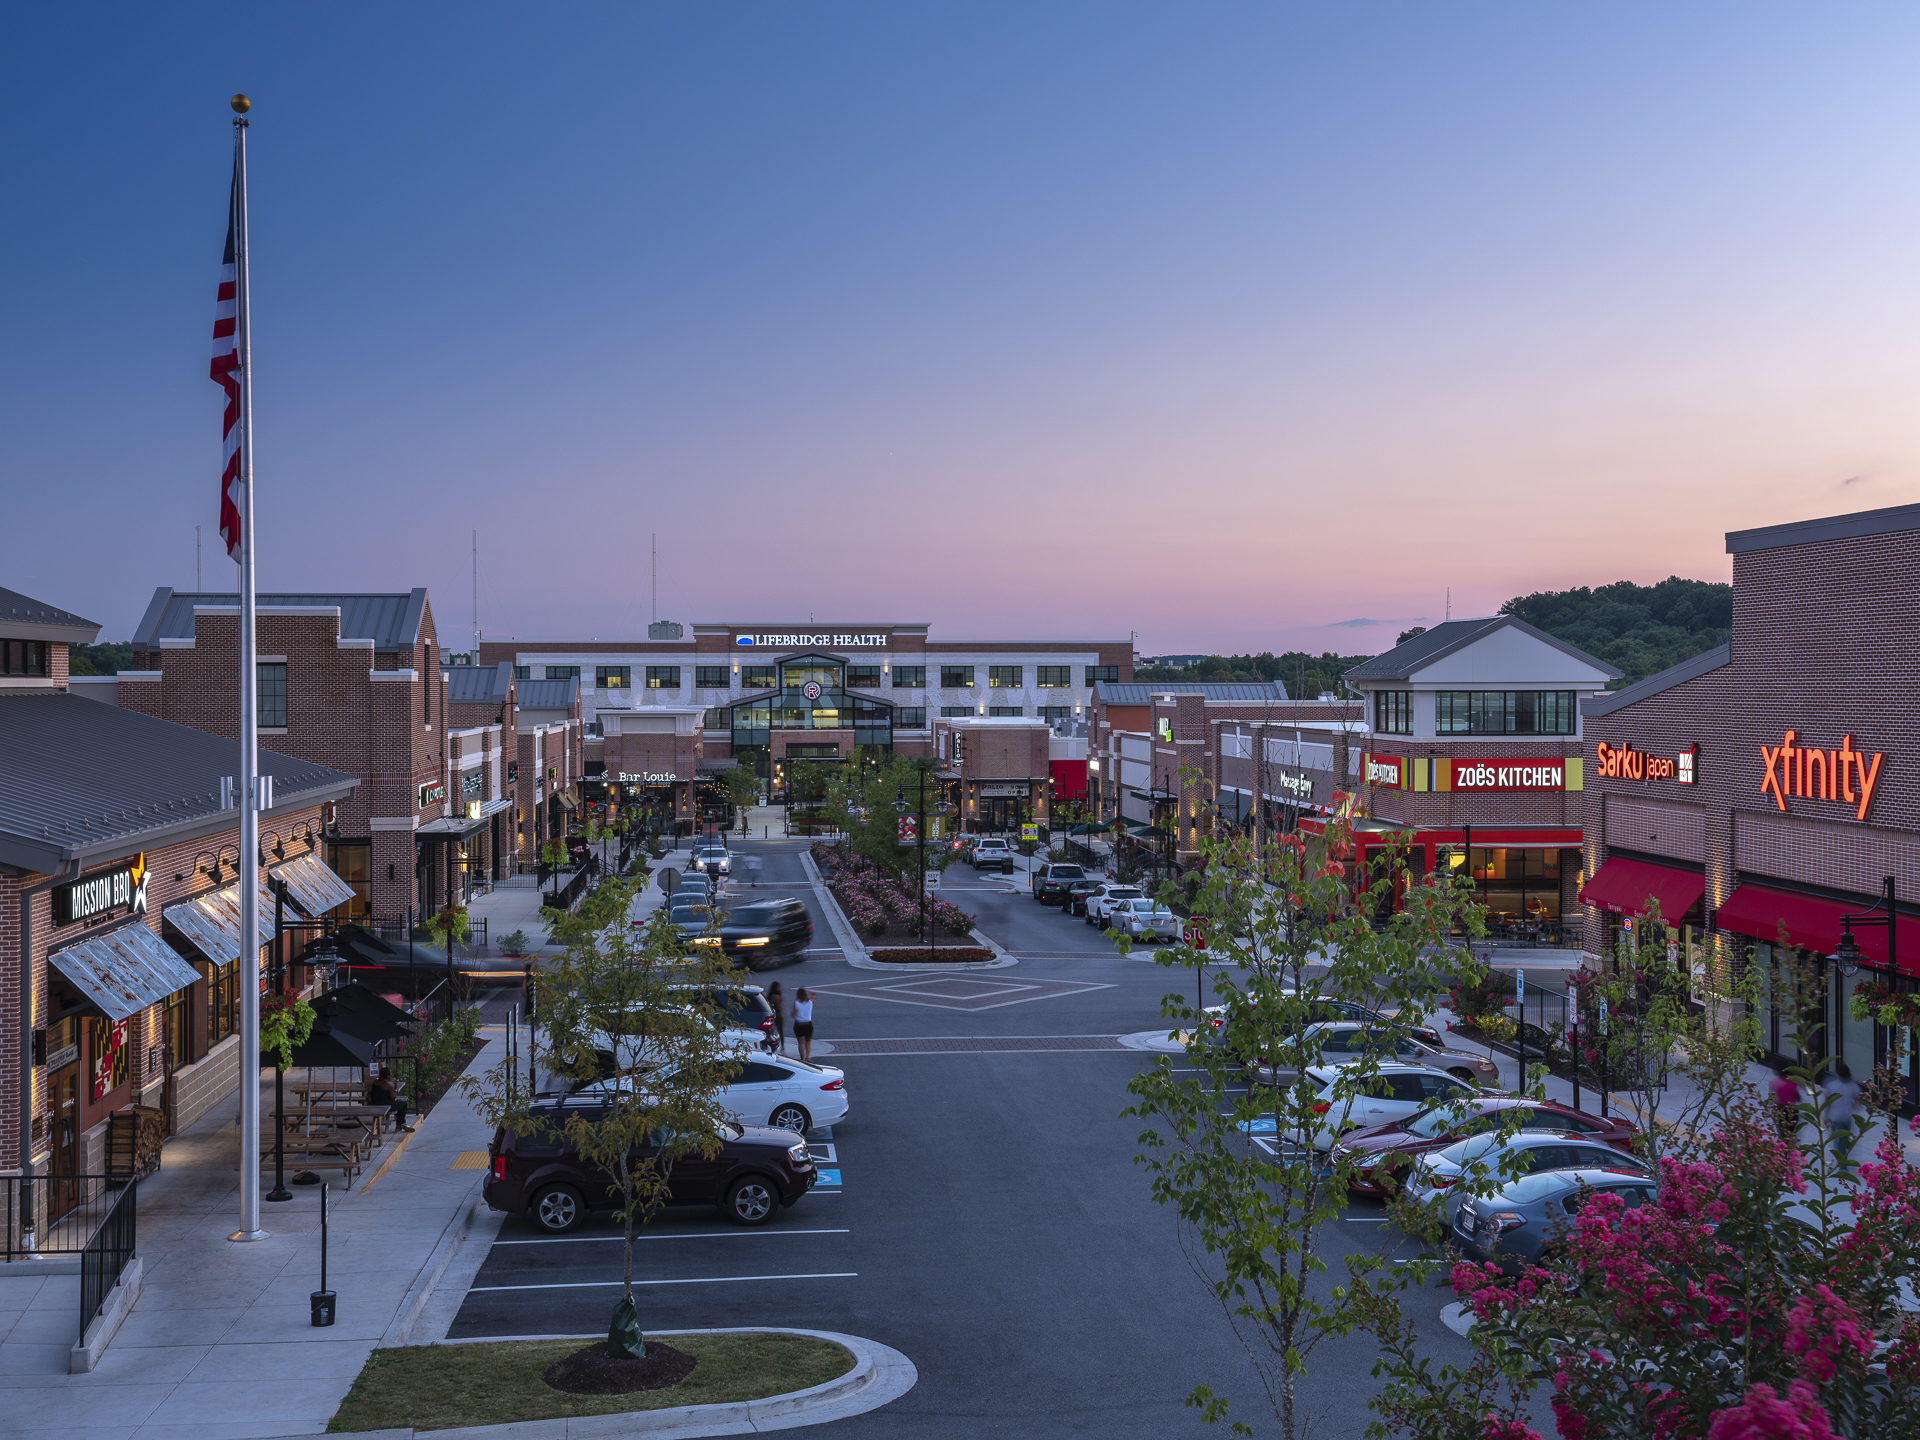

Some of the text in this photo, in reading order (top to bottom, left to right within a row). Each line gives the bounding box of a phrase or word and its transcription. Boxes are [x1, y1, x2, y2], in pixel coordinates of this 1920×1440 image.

[755, 635, 887, 646] LIFEBRIDGE HEALTH
[1598, 741, 1674, 781] Sarku japan
[619, 772, 676, 781] Bar Louie
[1300, 773, 1312, 798] Envy
[1498, 767, 1561, 786] KITCHEN
[1760, 730, 1882, 820] xfinity
[72, 870, 130, 919] MISSION BBQ
